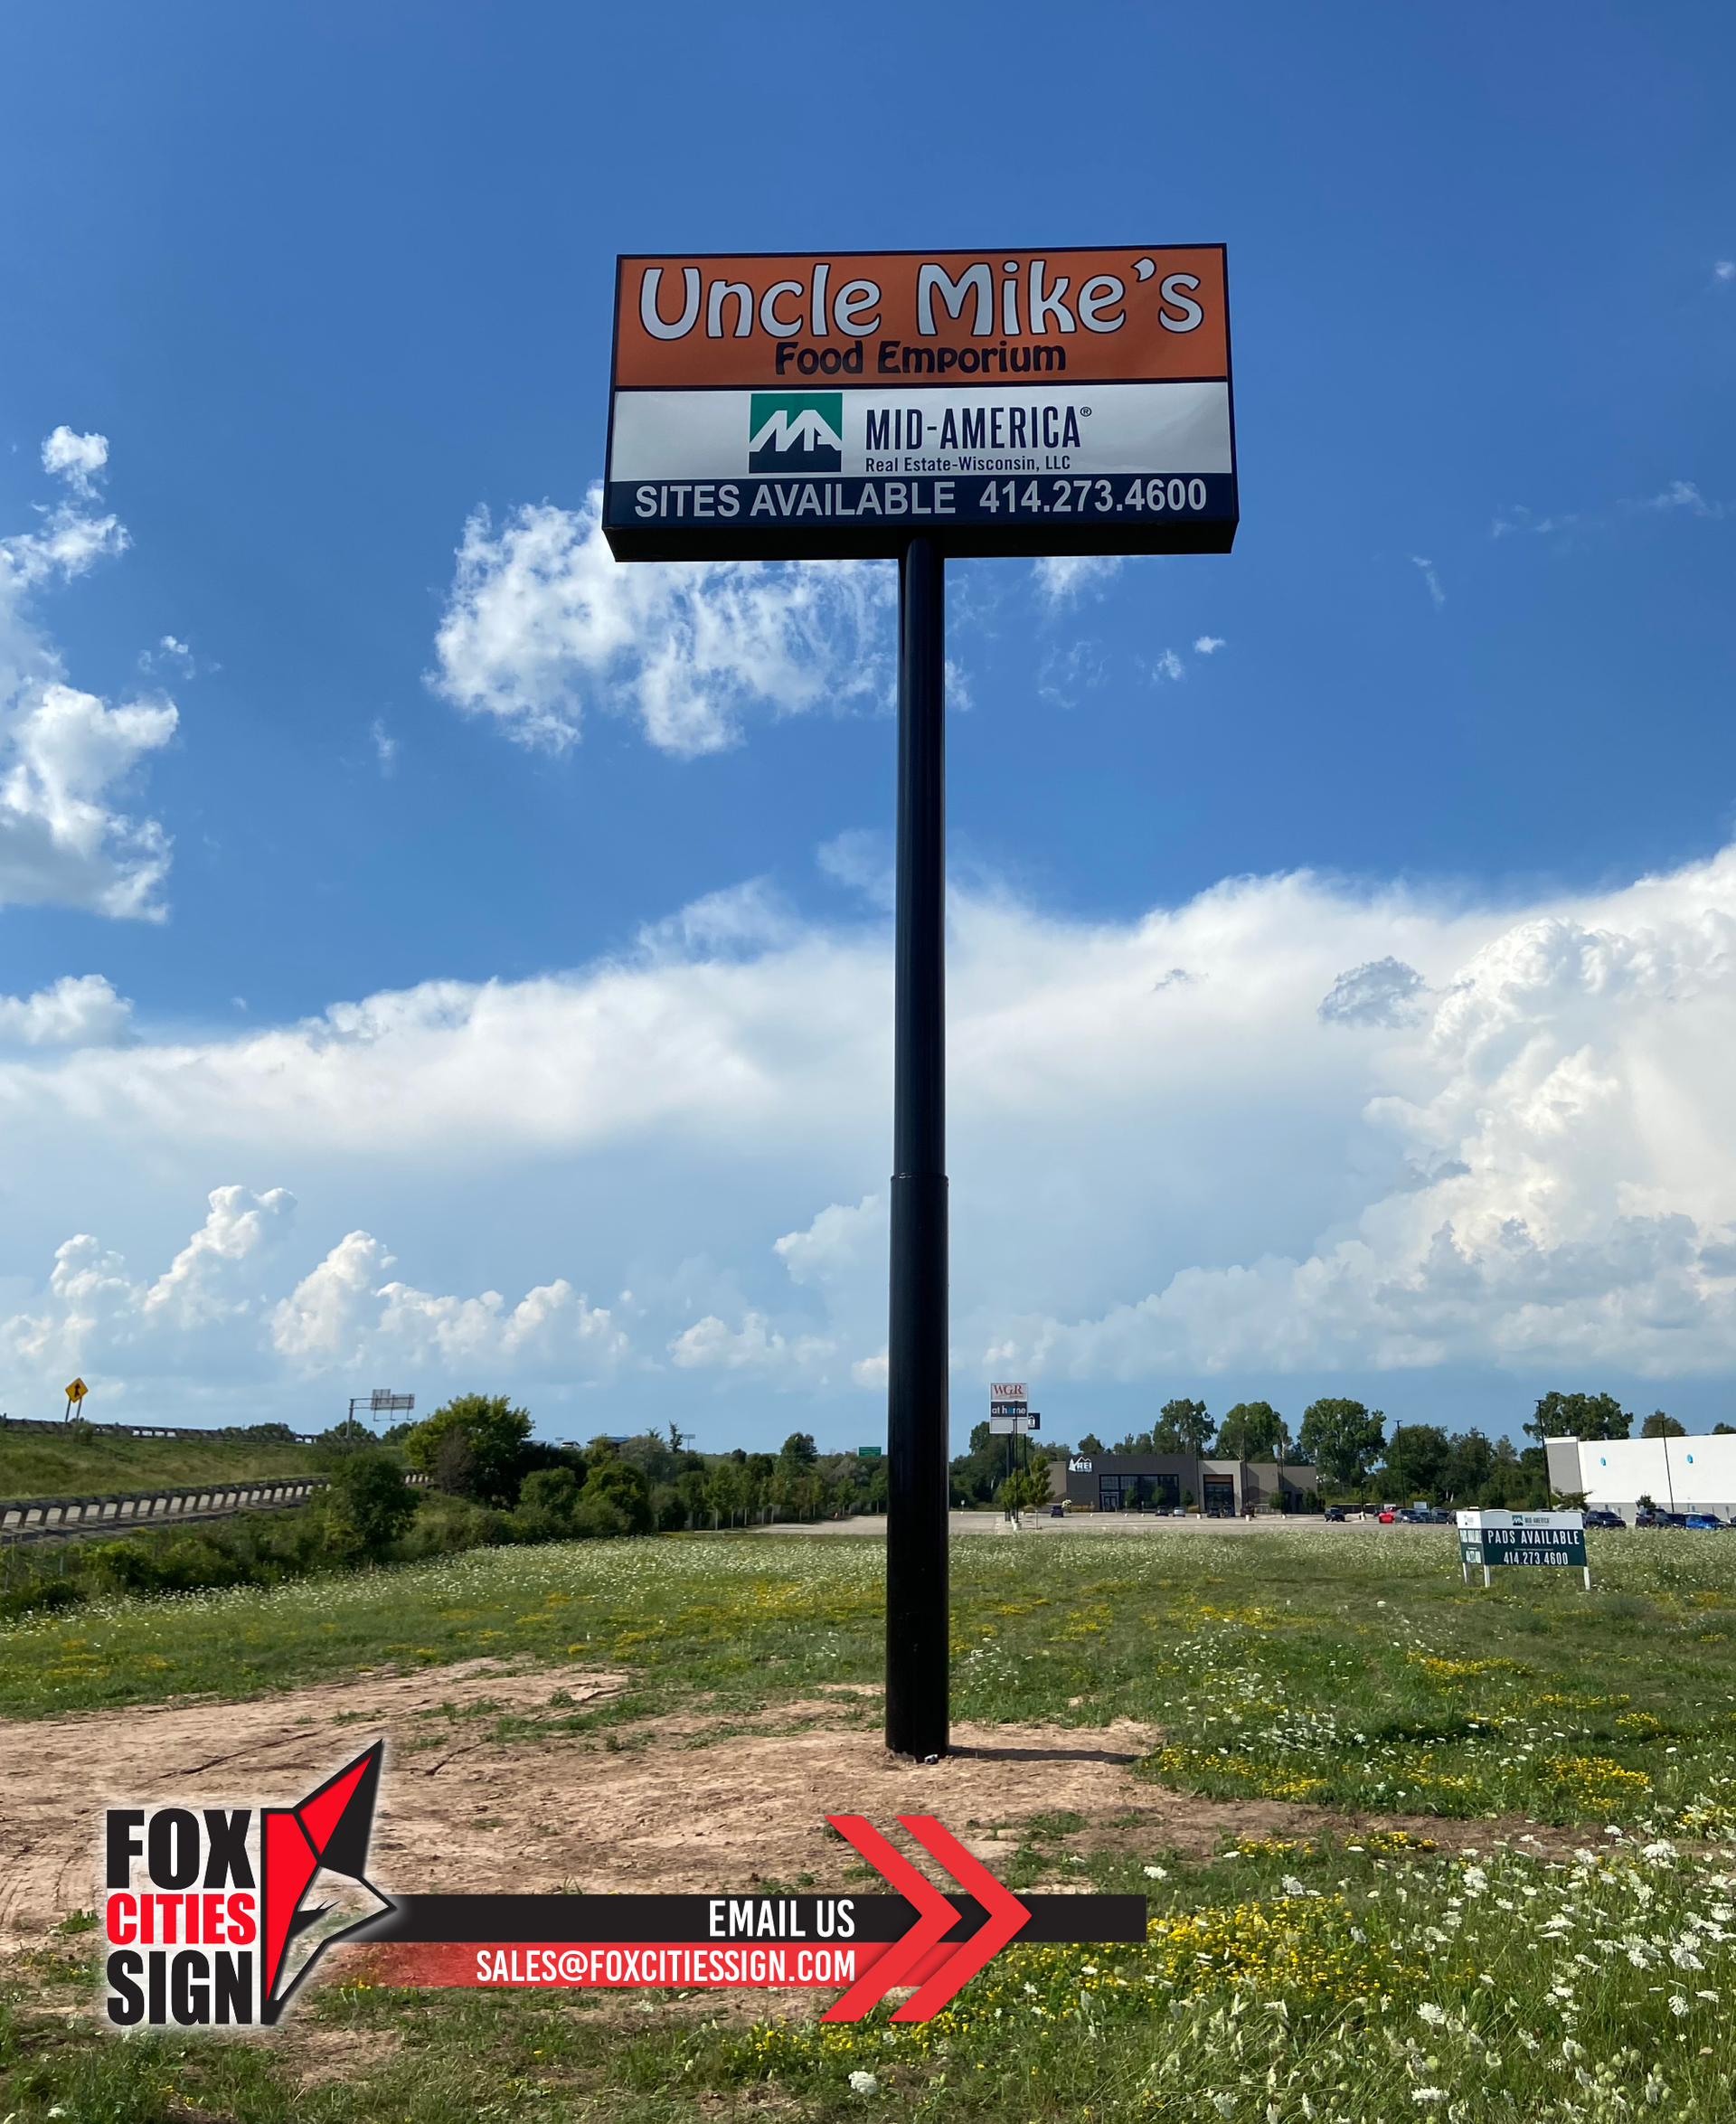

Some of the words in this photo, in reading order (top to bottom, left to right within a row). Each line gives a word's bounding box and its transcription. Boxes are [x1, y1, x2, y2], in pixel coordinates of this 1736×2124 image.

[639, 263, 882, 341] Uncle
[916, 257, 1203, 337] Mike's
[776, 341, 863, 375] Food
[878, 339, 1066, 375] Emporium
[865, 458, 899, 472] Real
[904, 456, 1040, 473] Estate-Wisconsin,
[1045, 455, 1071, 470] LLC
[635, 485, 741, 518] SITES
[750, 481, 956, 517] AVAILABLE
[979, 478, 1207, 514] 414.273.4600
[1487, 1530, 1516, 1544] PADS
[1521, 1530, 1580, 1545] AVAILABLE
[1504, 1552, 1569, 1565] 414.273.4600
